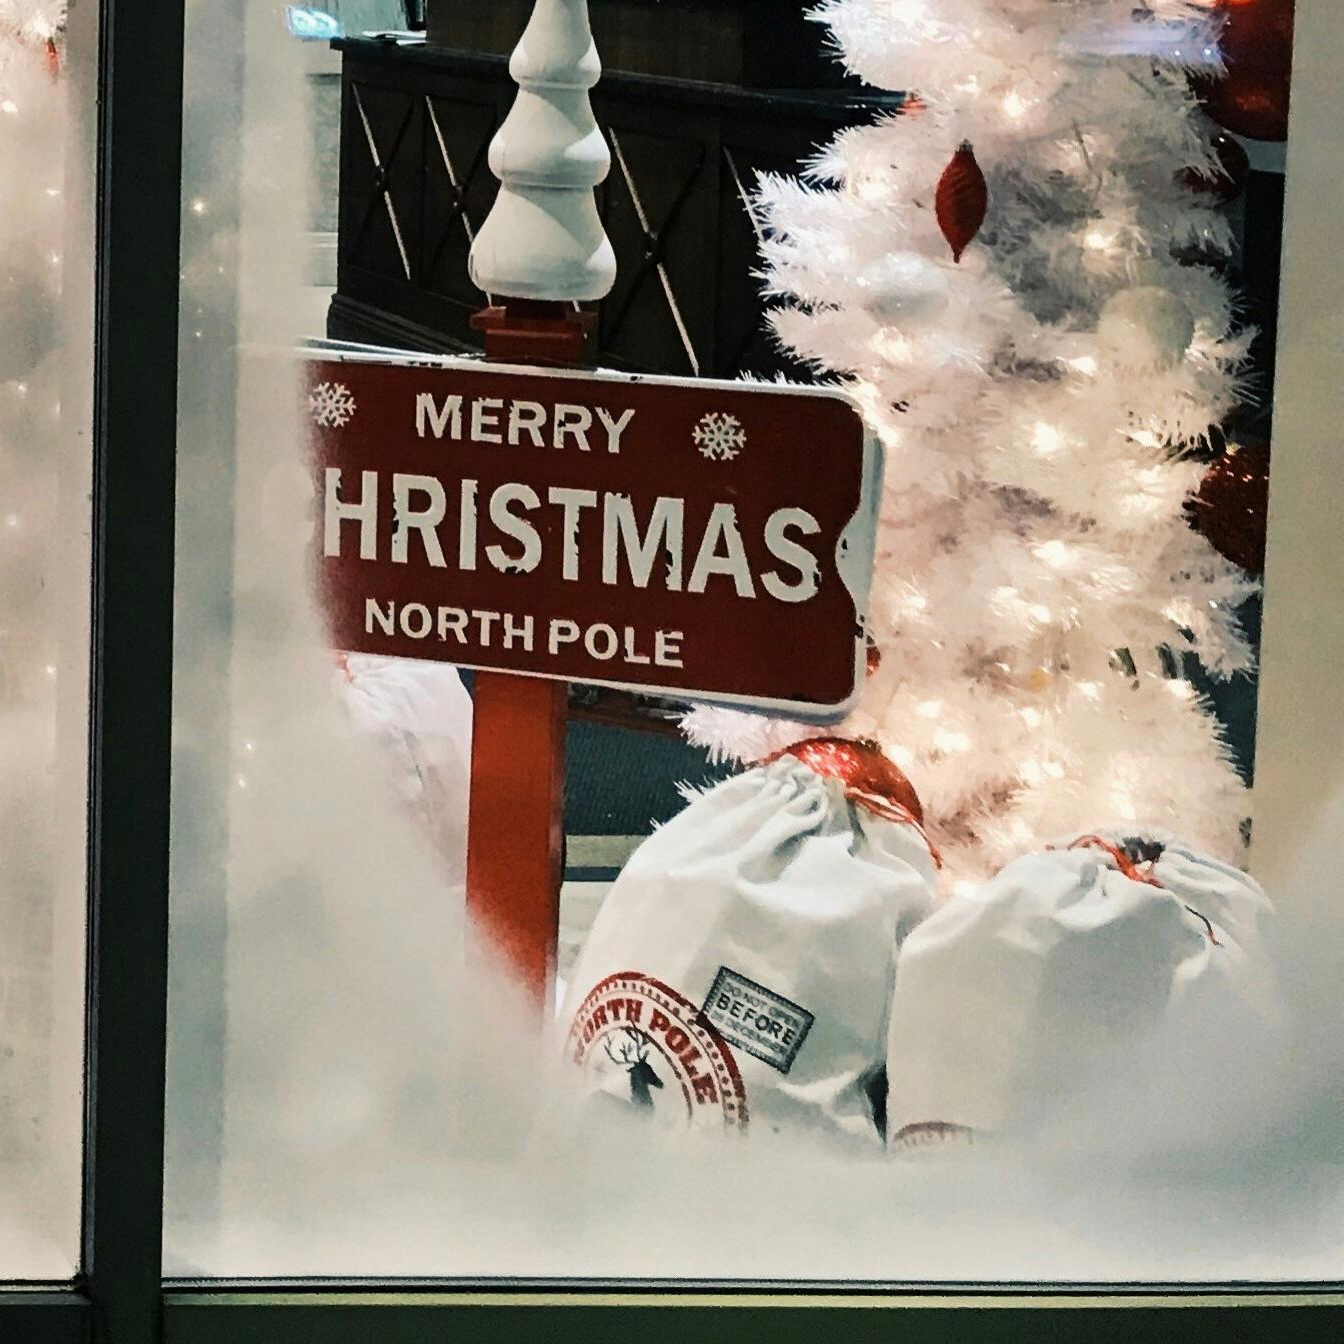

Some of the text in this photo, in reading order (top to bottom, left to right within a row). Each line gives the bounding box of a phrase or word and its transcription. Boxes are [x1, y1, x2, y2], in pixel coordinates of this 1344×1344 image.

[415, 392, 636, 455] MERRY
[324, 467, 822, 604] HRISTMAS
[365, 598, 685, 669] NORTH POLE
[716, 993, 795, 1045] BEFORE
[649, 1008, 718, 1105] POLE
